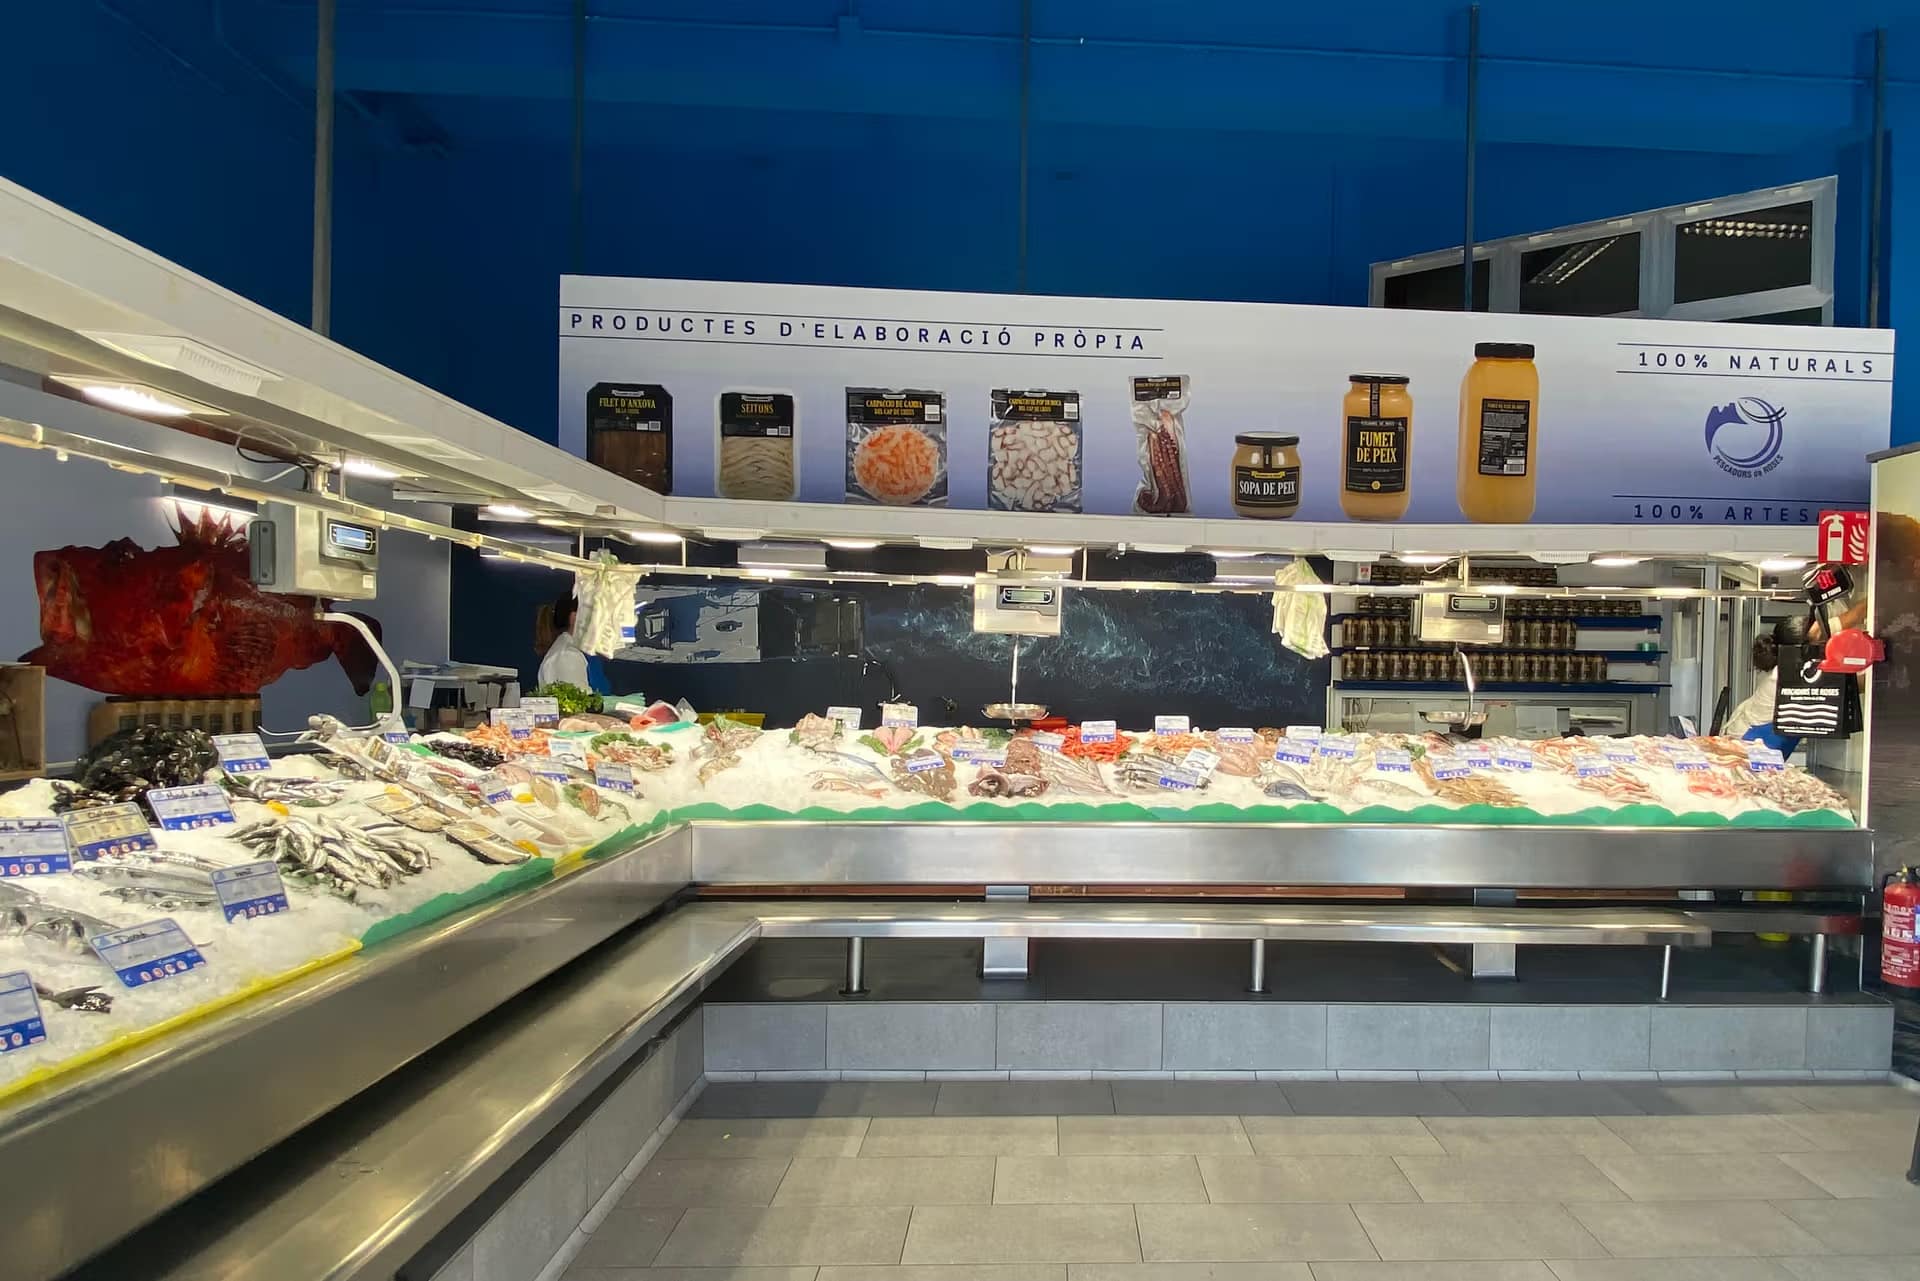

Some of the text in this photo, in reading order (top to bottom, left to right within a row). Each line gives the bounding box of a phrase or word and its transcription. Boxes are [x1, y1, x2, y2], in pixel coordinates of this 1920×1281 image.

[571, 313, 1144, 351] PRODUCTES D'ELABORACIÓ PRÒPIA
[1638, 352, 1873, 374] 100% NATURALS
[599, 397, 656, 409] FILET D'ANXOVA
[741, 403, 774, 414] SEITONS
[1359, 431, 1395, 447] FUMET
[1356, 447, 1397, 464] DE PEIX
[1713, 455, 1752, 479] PESCADORS
[1762, 453, 1784, 474] ROSES
[1239, 480, 1296, 496] SOPA DE PEIX
[1633, 504, 1819, 522] 100% ARTES
